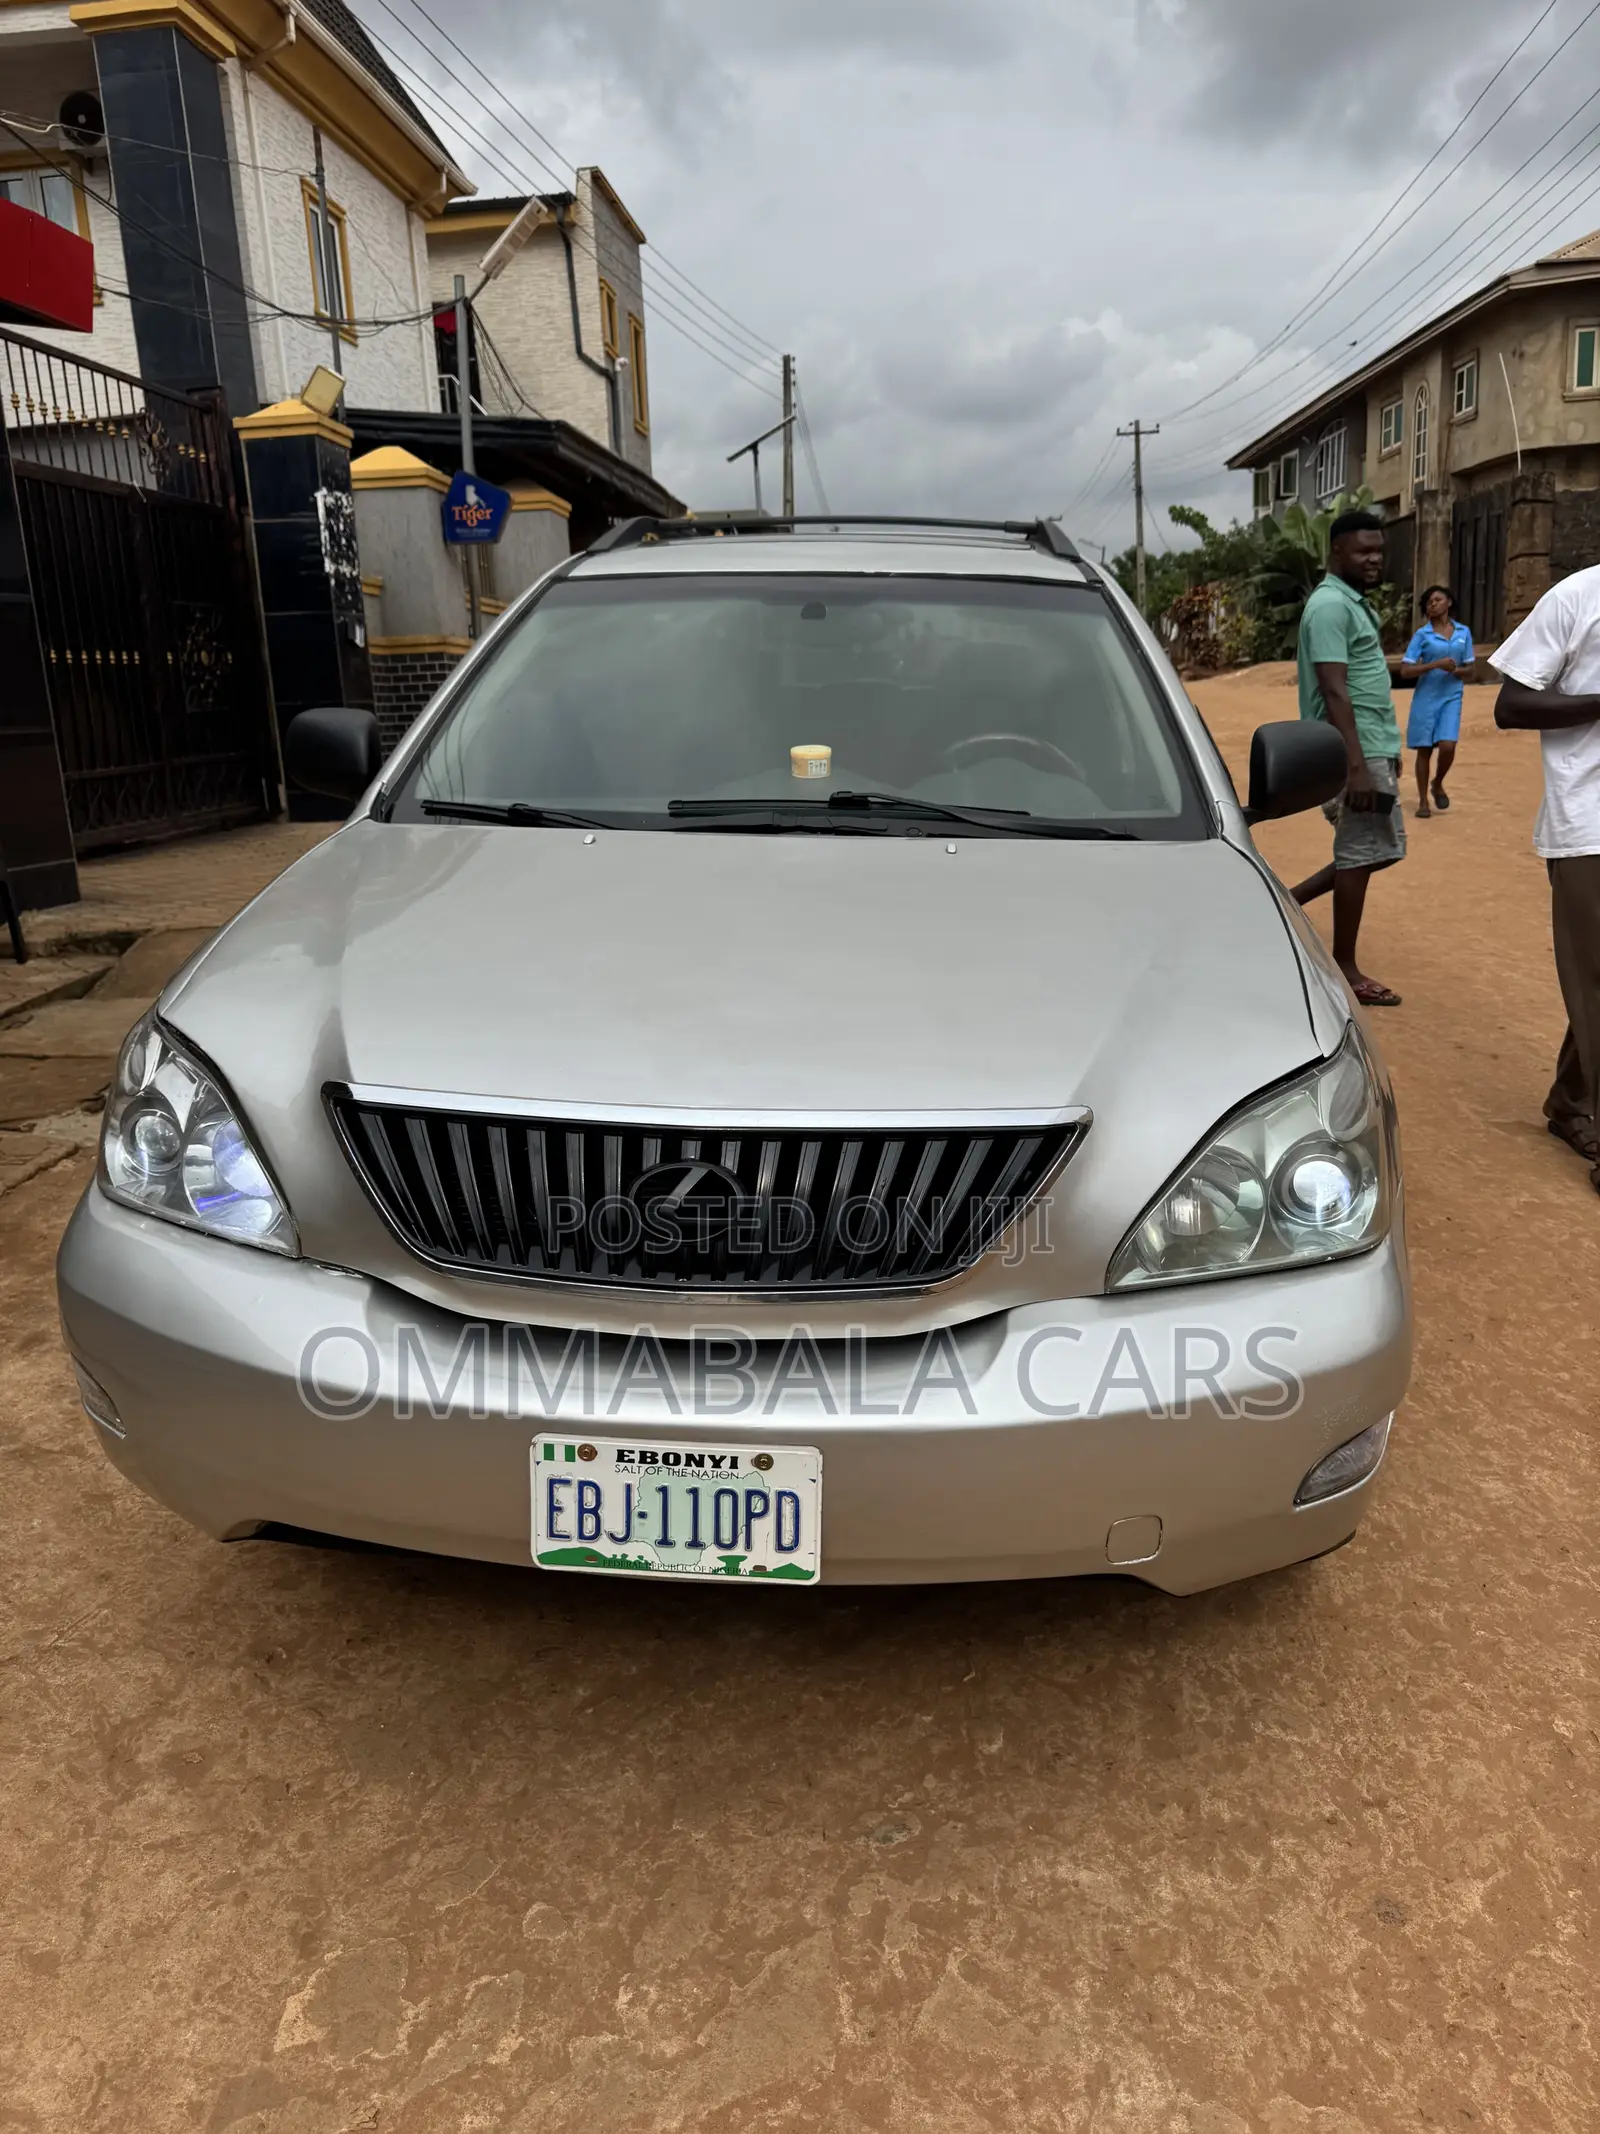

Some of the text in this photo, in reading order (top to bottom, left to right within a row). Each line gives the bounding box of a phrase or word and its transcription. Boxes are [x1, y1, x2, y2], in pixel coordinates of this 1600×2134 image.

[451, 504, 494, 527] Tiger
[616, 1449, 739, 1469] EBONYI
[615, 1464, 739, 1479] SALT OF THE NATION
[547, 1476, 801, 1553] EBJ-110PD
[602, 1559, 748, 1576] FEDERAL REPUBLIC OF NIGERIA
